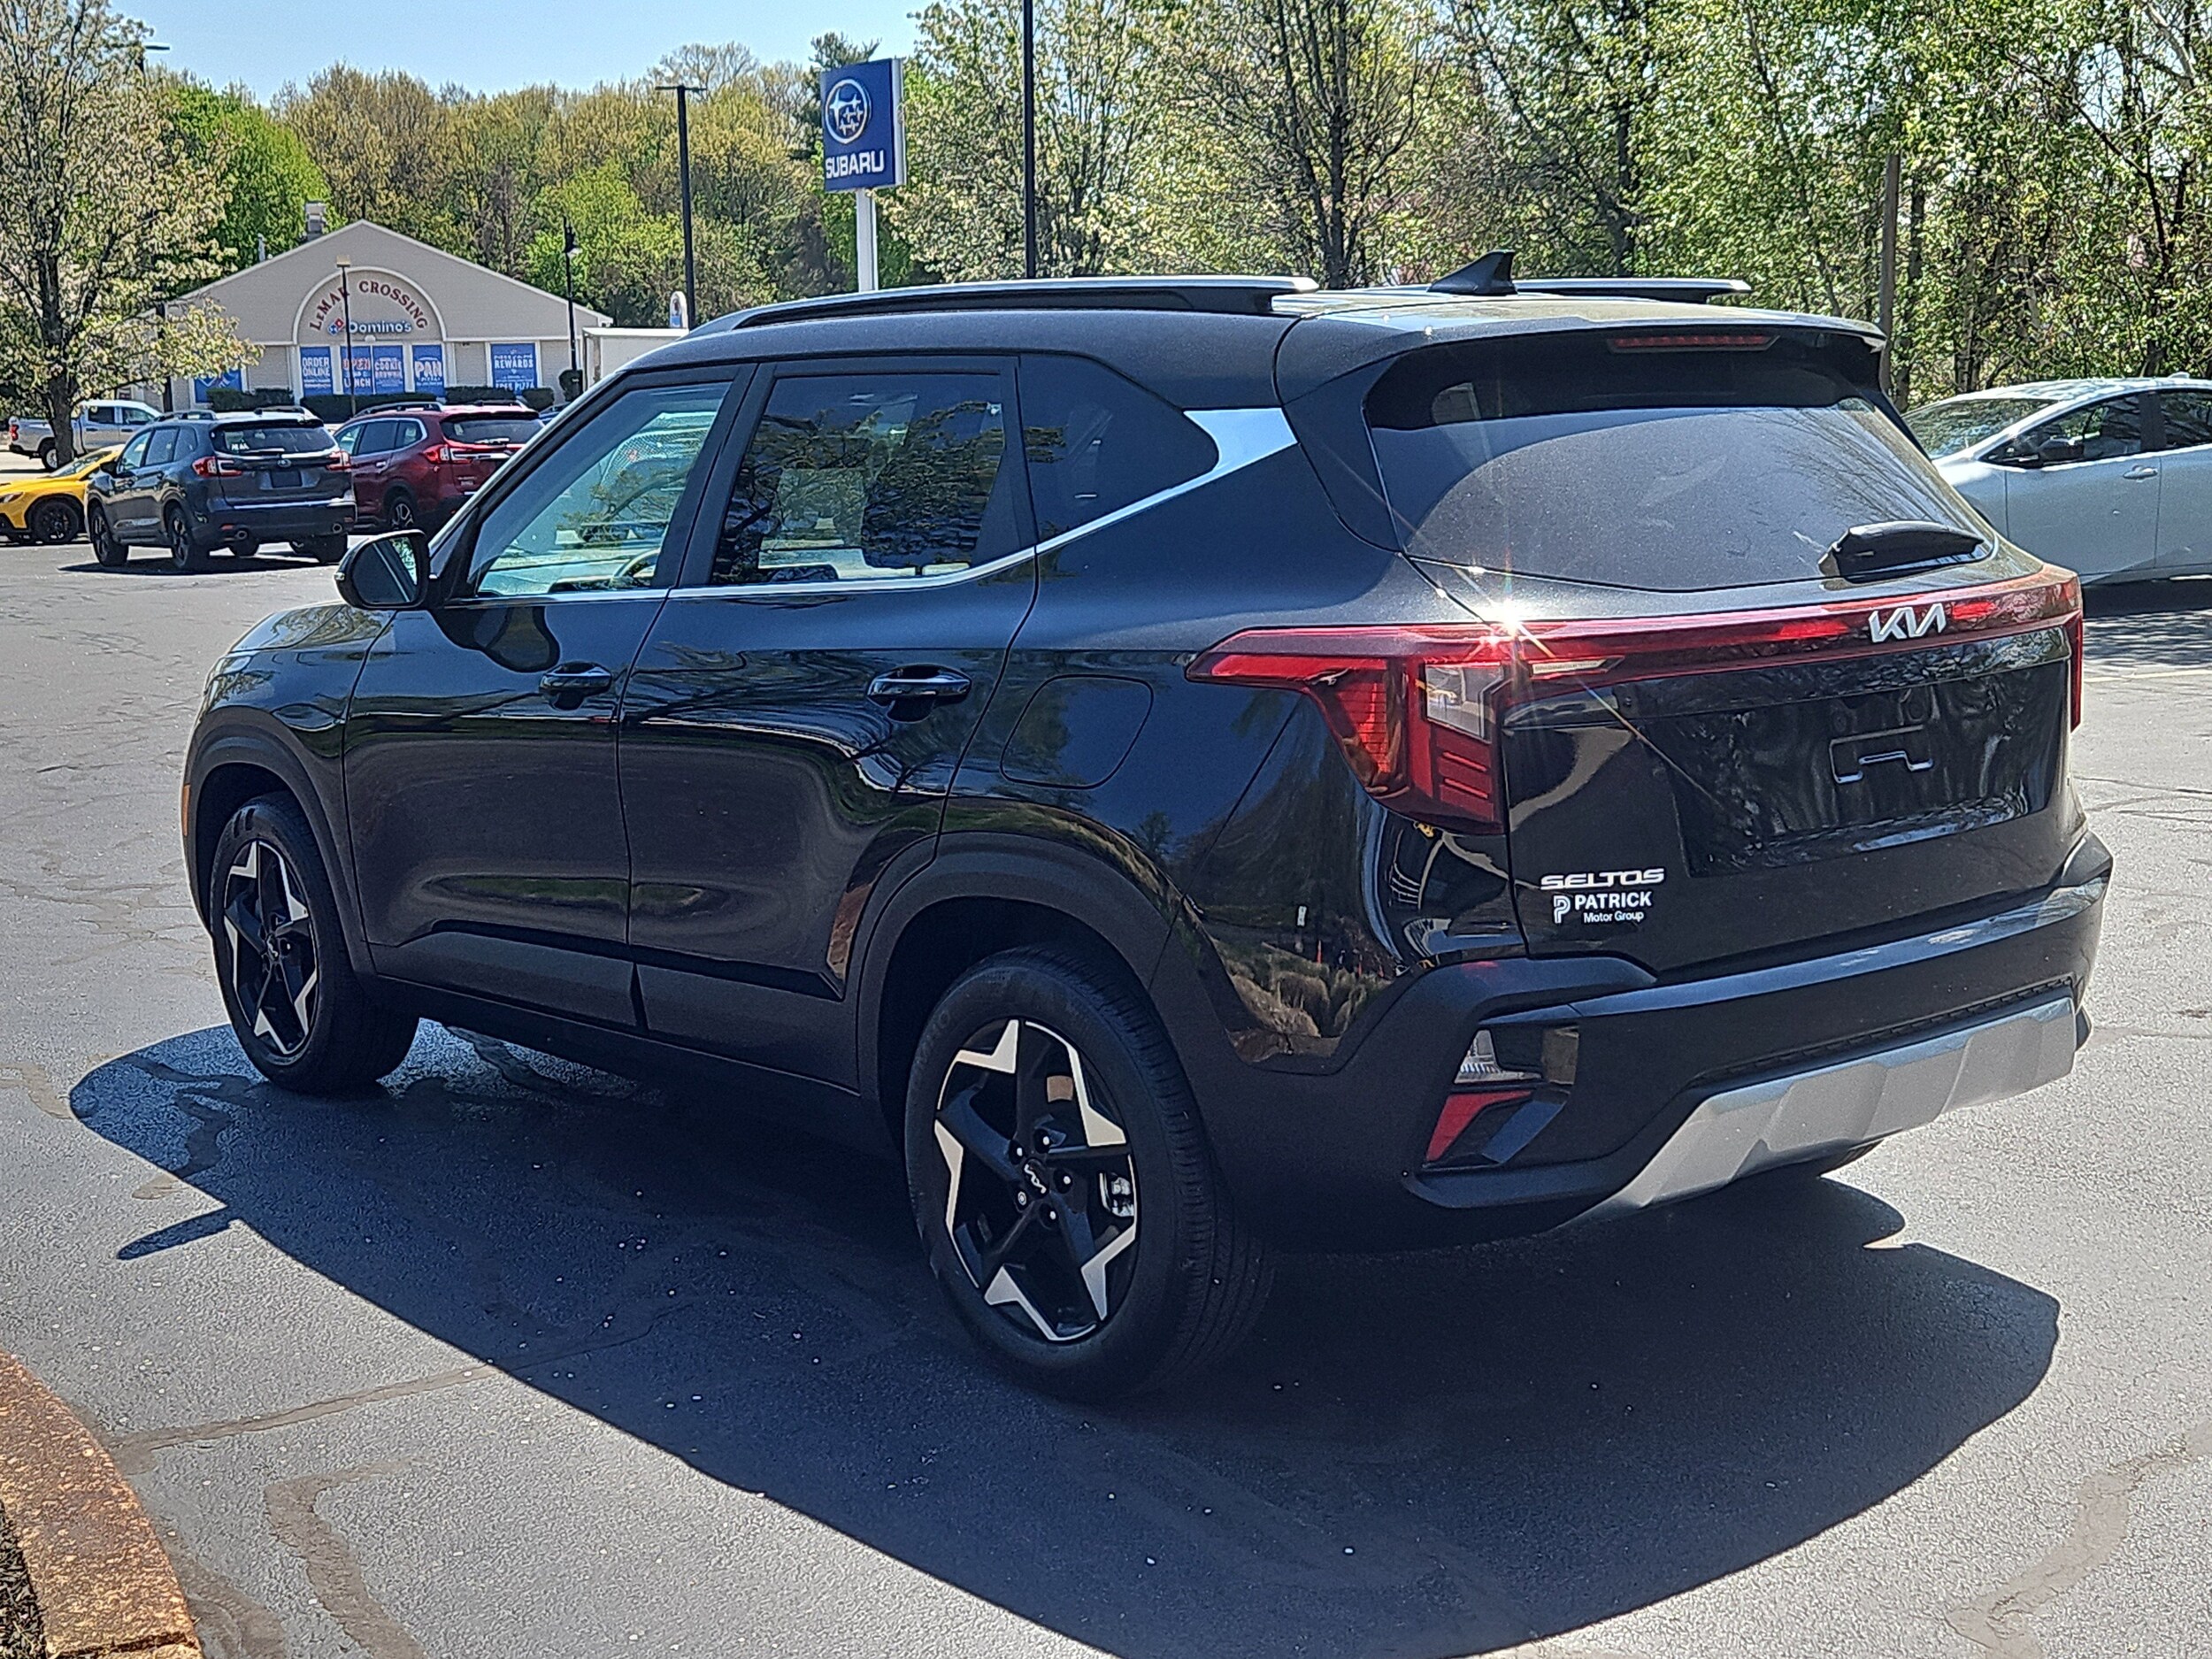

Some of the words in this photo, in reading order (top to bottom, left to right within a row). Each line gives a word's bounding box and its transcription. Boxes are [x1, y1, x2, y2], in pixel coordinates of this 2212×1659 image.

[825, 150, 885, 180] SUBARU
[358, 280, 428, 330] CROSSING
[349, 320, 412, 334] Domino's
[302, 357, 330, 368] ORDER
[415, 361, 442, 378] PAN
[494, 359, 534, 369] REWARDS
[302, 367, 331, 377] ONLINE
[1868, 603, 1947, 643] KIA
[1540, 867, 1665, 891] SELTOS
[1574, 891, 1653, 910] PATRICK
[1583, 912, 1613, 924] Motor
[1614, 910, 1645, 923] Group
